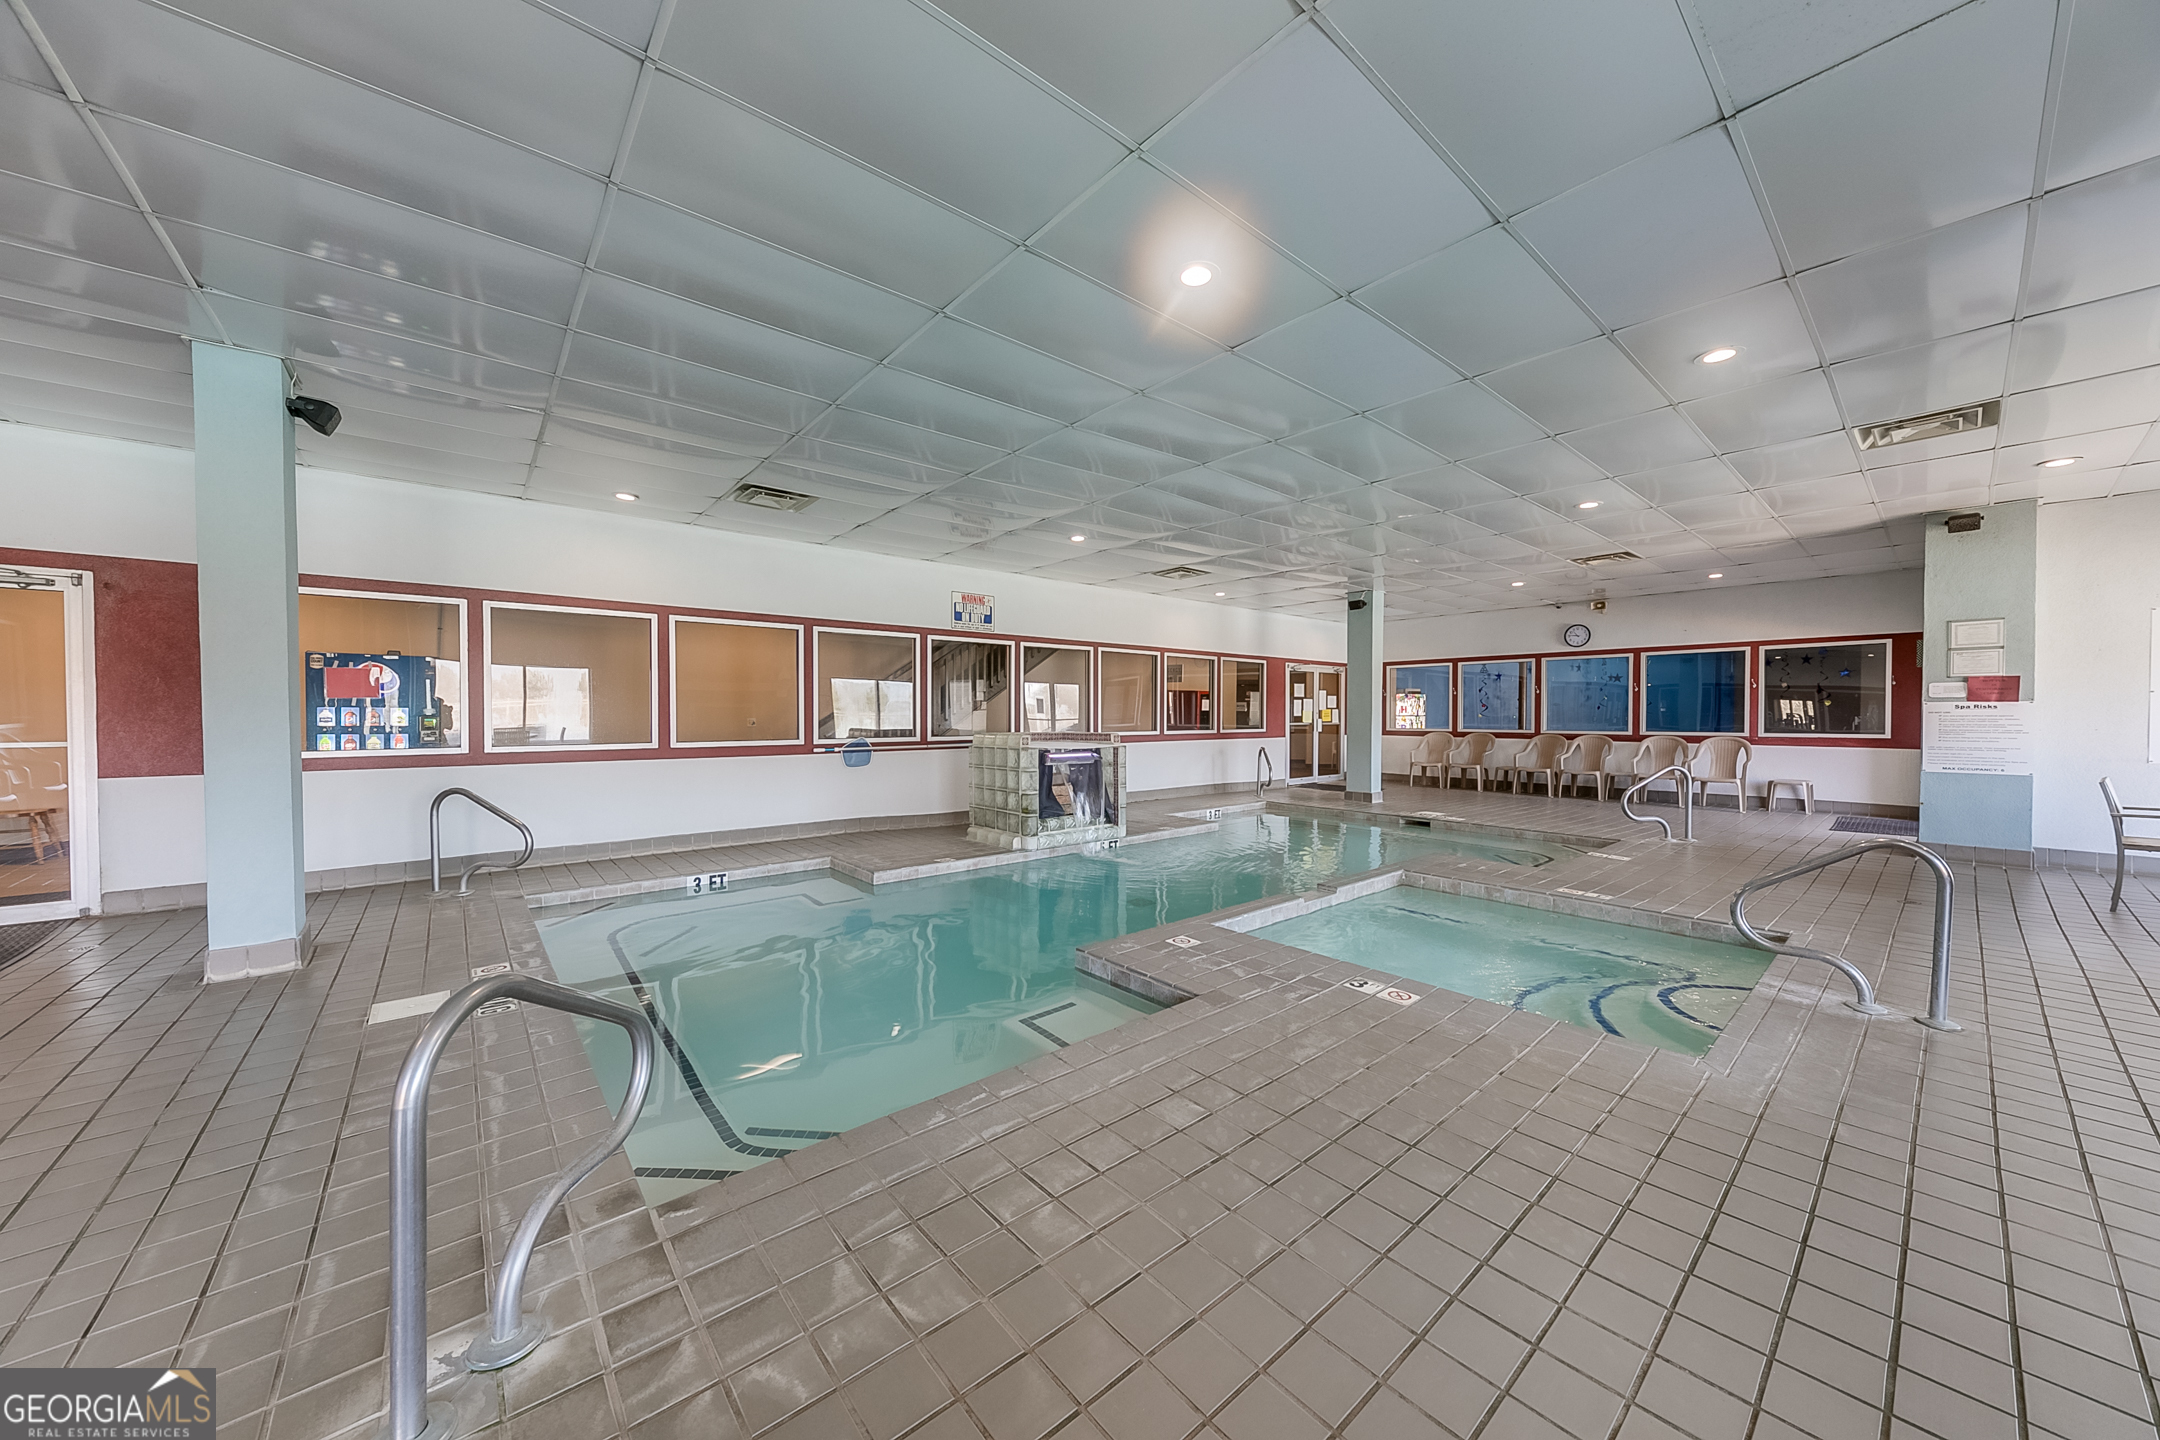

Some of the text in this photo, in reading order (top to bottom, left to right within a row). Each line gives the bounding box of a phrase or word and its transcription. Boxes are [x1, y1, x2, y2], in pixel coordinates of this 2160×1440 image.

[961, 593, 986, 606] WARNING
[955, 602, 991, 616] NO LIFEGUARD
[961, 612, 985, 624] ON DUTY
[693, 876, 702, 894] 3
